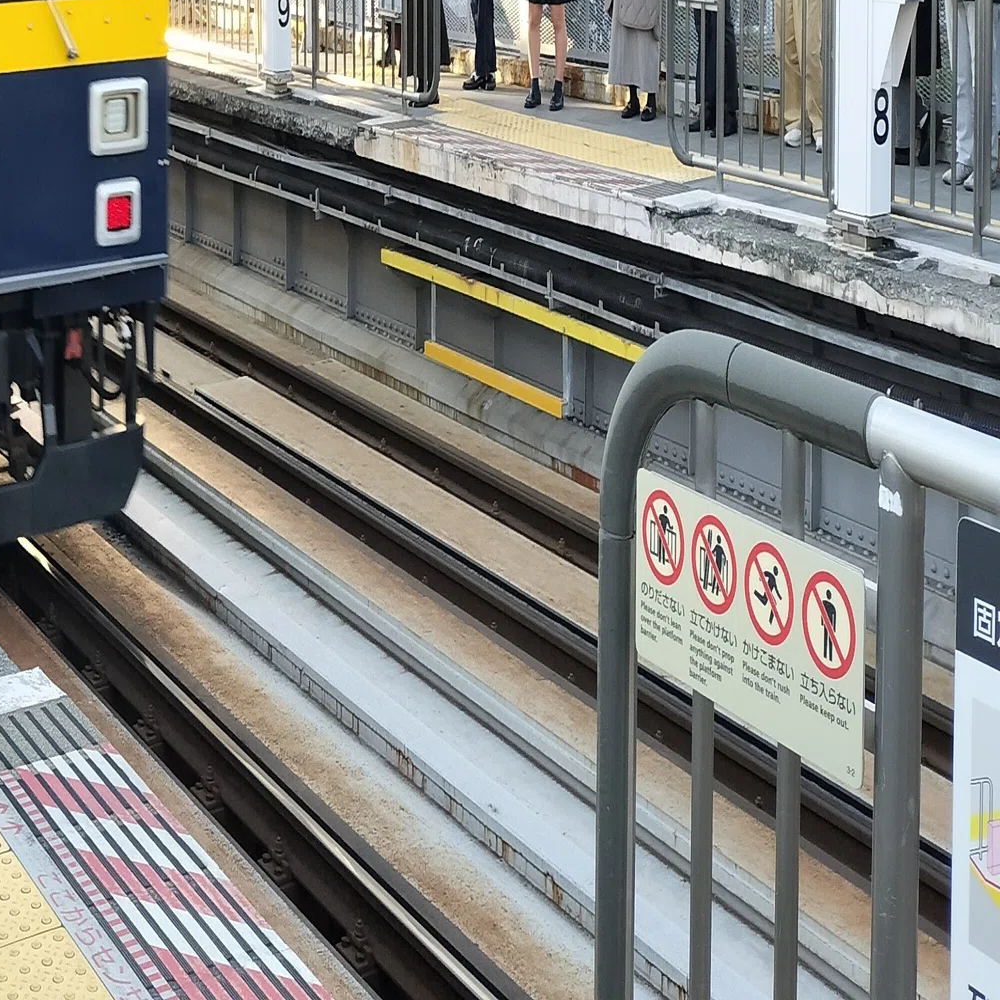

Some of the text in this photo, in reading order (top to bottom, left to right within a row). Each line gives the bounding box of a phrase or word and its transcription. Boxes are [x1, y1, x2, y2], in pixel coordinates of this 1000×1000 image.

[873, 87, 889, 145] 8
[640, 600, 682, 631] Please don't lean
[641, 581, 685, 617] のりださない
[640, 614, 684, 646] over the platform
[640, 624, 658, 643] barrier.
[690, 608, 737, 648] 立てかけない
[689, 629, 735, 664] Please don't prop
[689, 644, 734, 676] anything against
[742, 639, 794, 681] かけこまない
[689, 656, 722, 682] the platform
[689, 667, 708, 687] barrier.
[742, 660, 790, 696] Please don't rush
[742, 673, 781, 705] into the train.
[800, 671, 856, 716] 立ち入らない
[799, 693, 850, 731] Please keep out.
